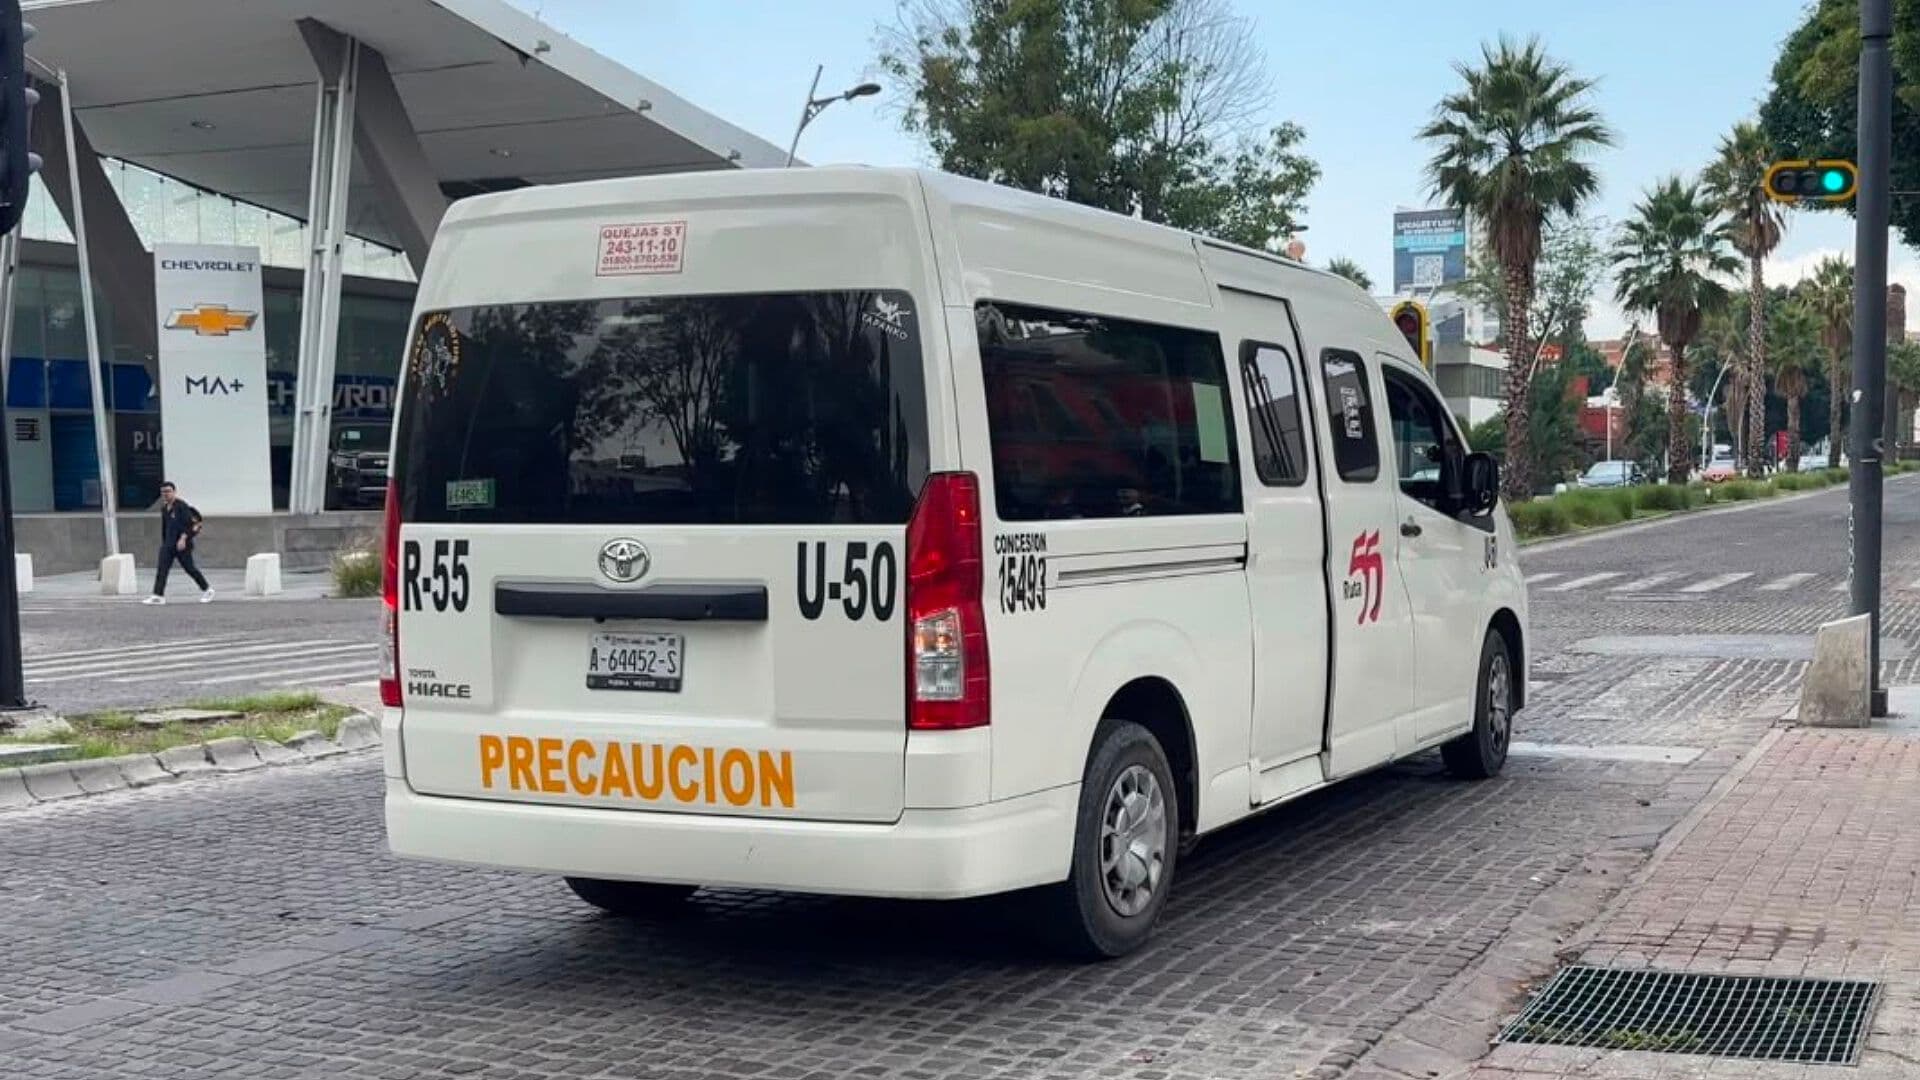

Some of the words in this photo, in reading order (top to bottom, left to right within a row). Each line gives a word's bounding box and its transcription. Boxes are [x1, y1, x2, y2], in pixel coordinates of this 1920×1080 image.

[602, 227, 658, 239] QUEJAS
[606, 238, 677, 255] 243-11-10
[161, 259, 256, 272] CHEVROLET
[994, 533, 1047, 554] CONCESION
[404, 539, 469, 612] R-55
[797, 541, 897, 621] U-50
[999, 556, 1047, 614] 15493
[1349, 528, 1382, 624] 55
[590, 647, 677, 673] A-64452-S
[408, 668, 437, 679] TOYOTA
[408, 681, 472, 698] HIACE
[480, 735, 795, 808] PRECAUCION
